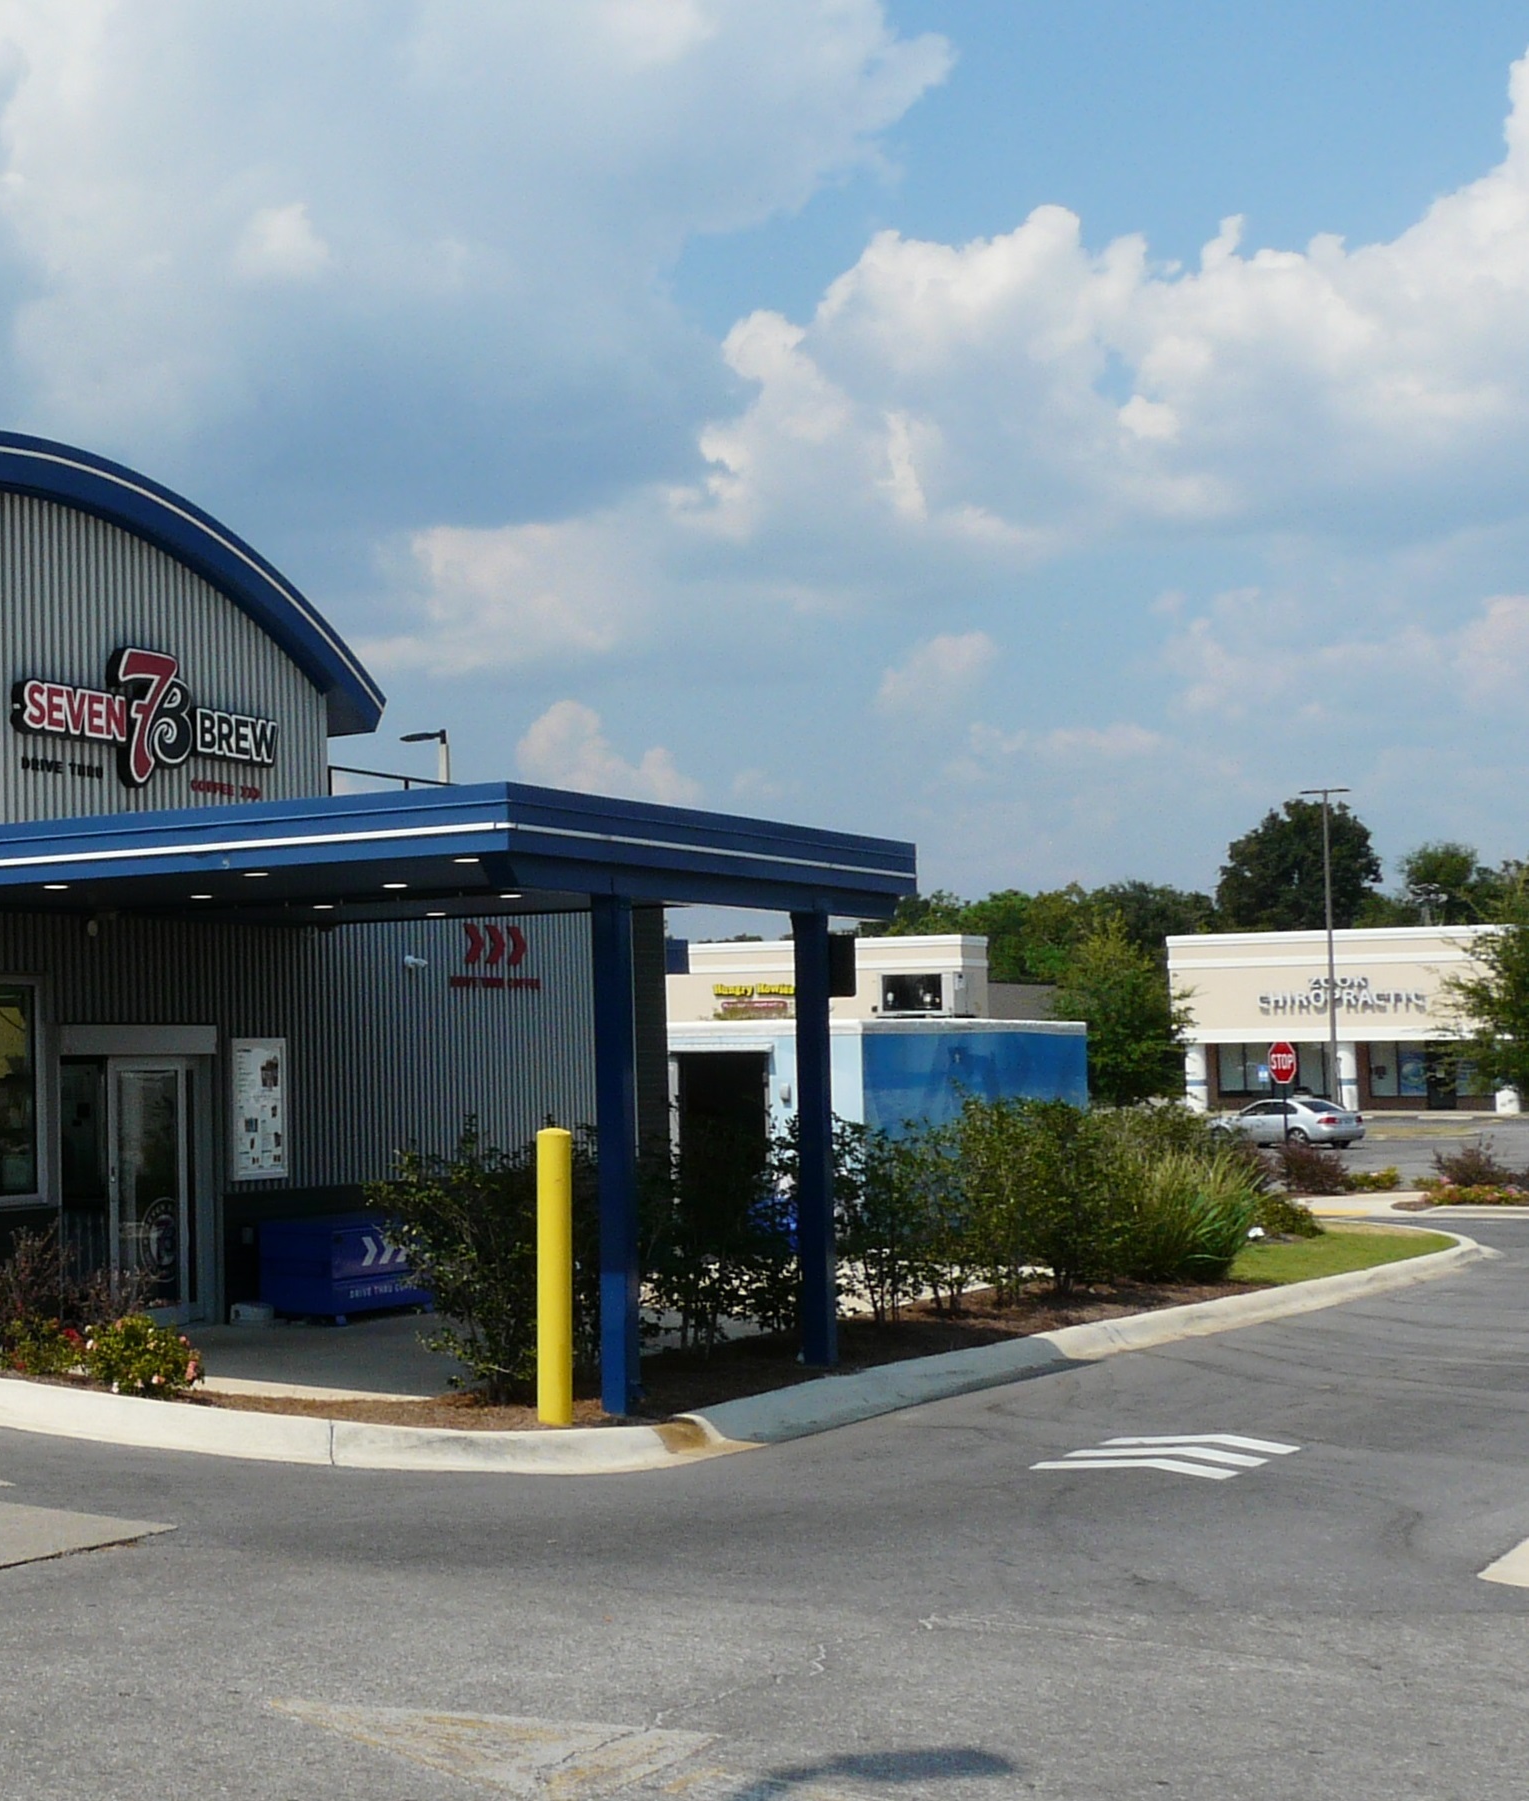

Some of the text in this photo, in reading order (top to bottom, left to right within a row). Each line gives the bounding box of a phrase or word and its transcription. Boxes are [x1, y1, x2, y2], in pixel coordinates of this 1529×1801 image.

[23, 680, 127, 743] SEVEN
[196, 708, 279, 764] BREW
[21, 755, 235, 797] DRIVE THRU COFFEE
[1270, 1053, 1294, 1070] STOP
